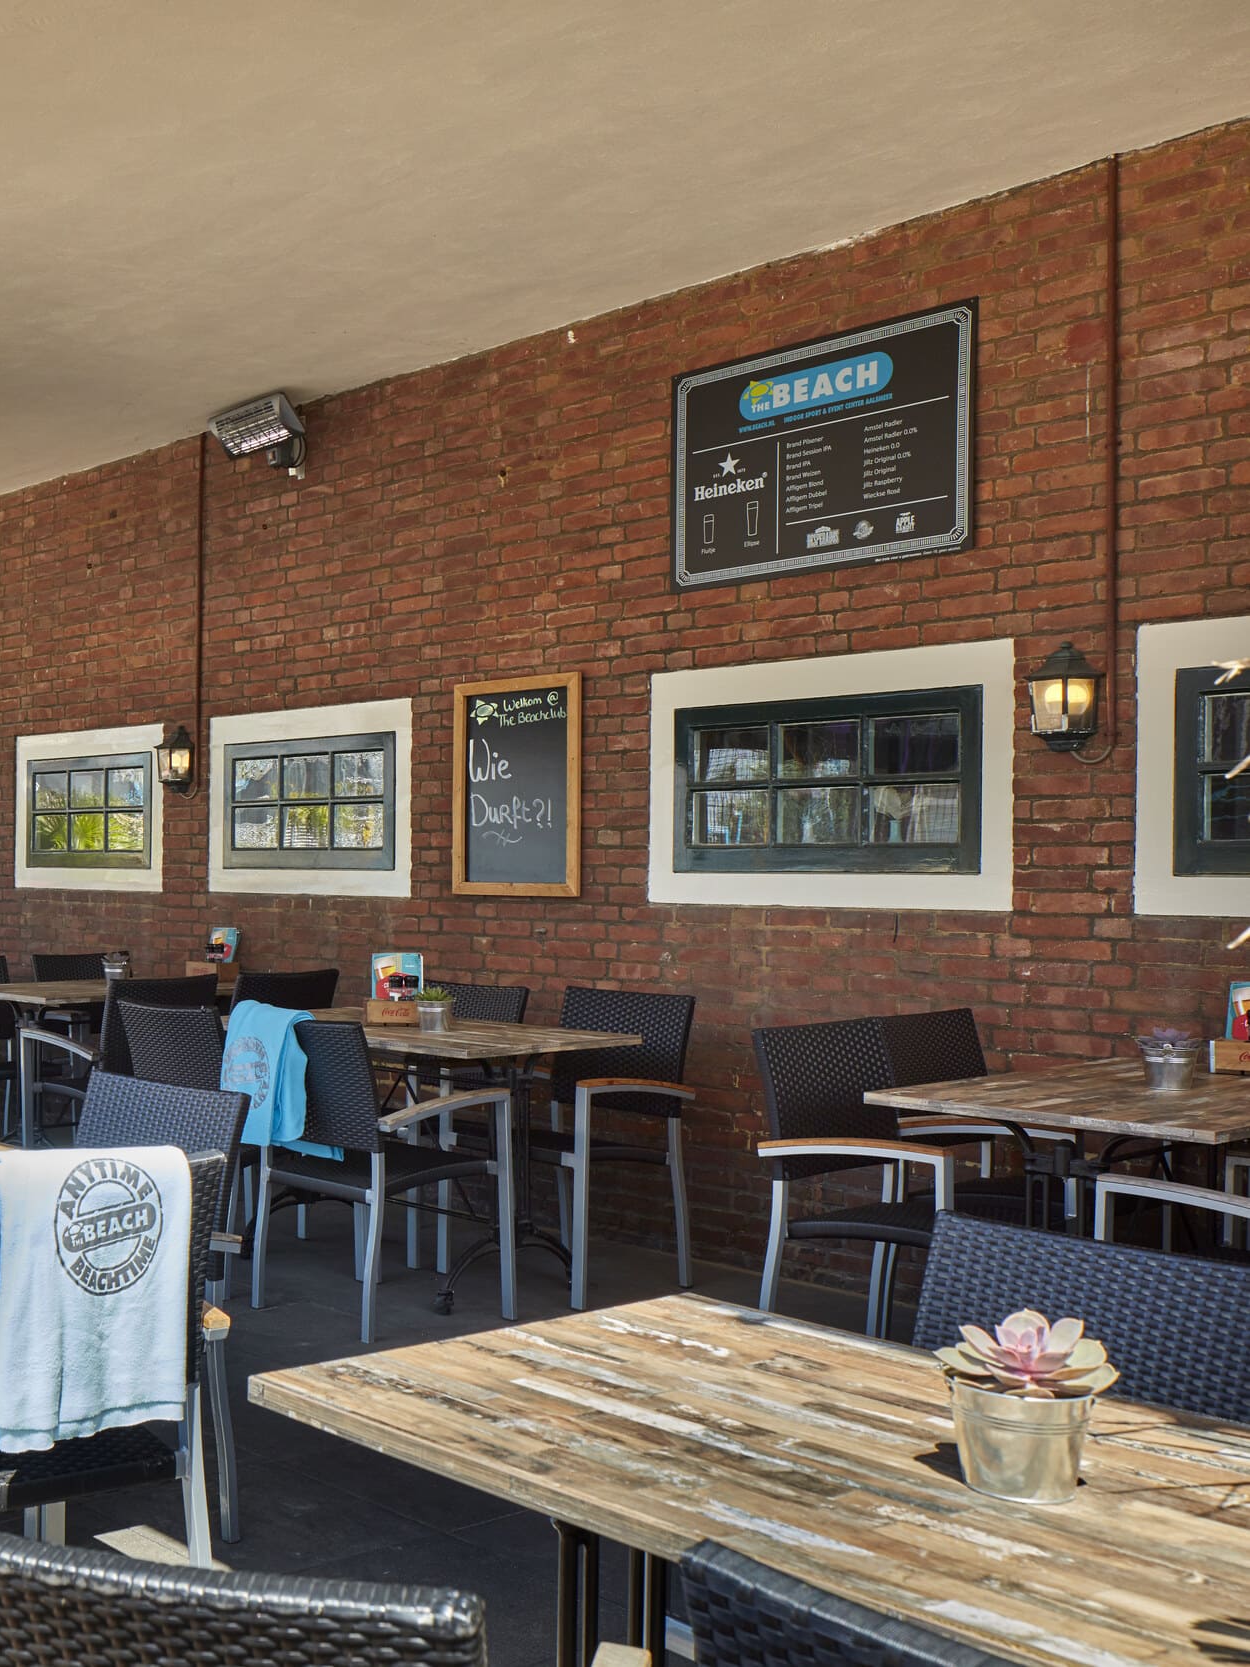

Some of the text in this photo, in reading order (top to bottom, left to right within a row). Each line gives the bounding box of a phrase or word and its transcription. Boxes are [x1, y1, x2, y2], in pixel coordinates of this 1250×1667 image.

[751, 360, 878, 413] THE BEACH
[805, 409, 822, 419] SPORT
[828, 403, 844, 414] EVENT
[845, 398, 865, 410] CENTER
[863, 419, 903, 432] Amstel Radler
[786, 440, 802, 449] Brand
[863, 434, 884, 443] Amstel
[884, 430, 903, 439] Radler
[786, 451, 802, 460] Brand
[823, 444, 832, 452] IPA
[890, 441, 901, 449] 0.0
[786, 462, 802, 471] Brand
[874, 454, 897, 464] Original
[786, 473, 802, 481] Brand
[873, 465, 897, 475] Original
[694, 478, 765, 501] Heineken
[503, 690, 559, 712] Welkom @
[497, 713, 517, 729] The
[468, 738, 512, 783] Wie
[60, 1161, 154, 1220] ANYTIME
[83, 1208, 149, 1242] BEACH
[69, 1235, 156, 1290] BEACHTIME
